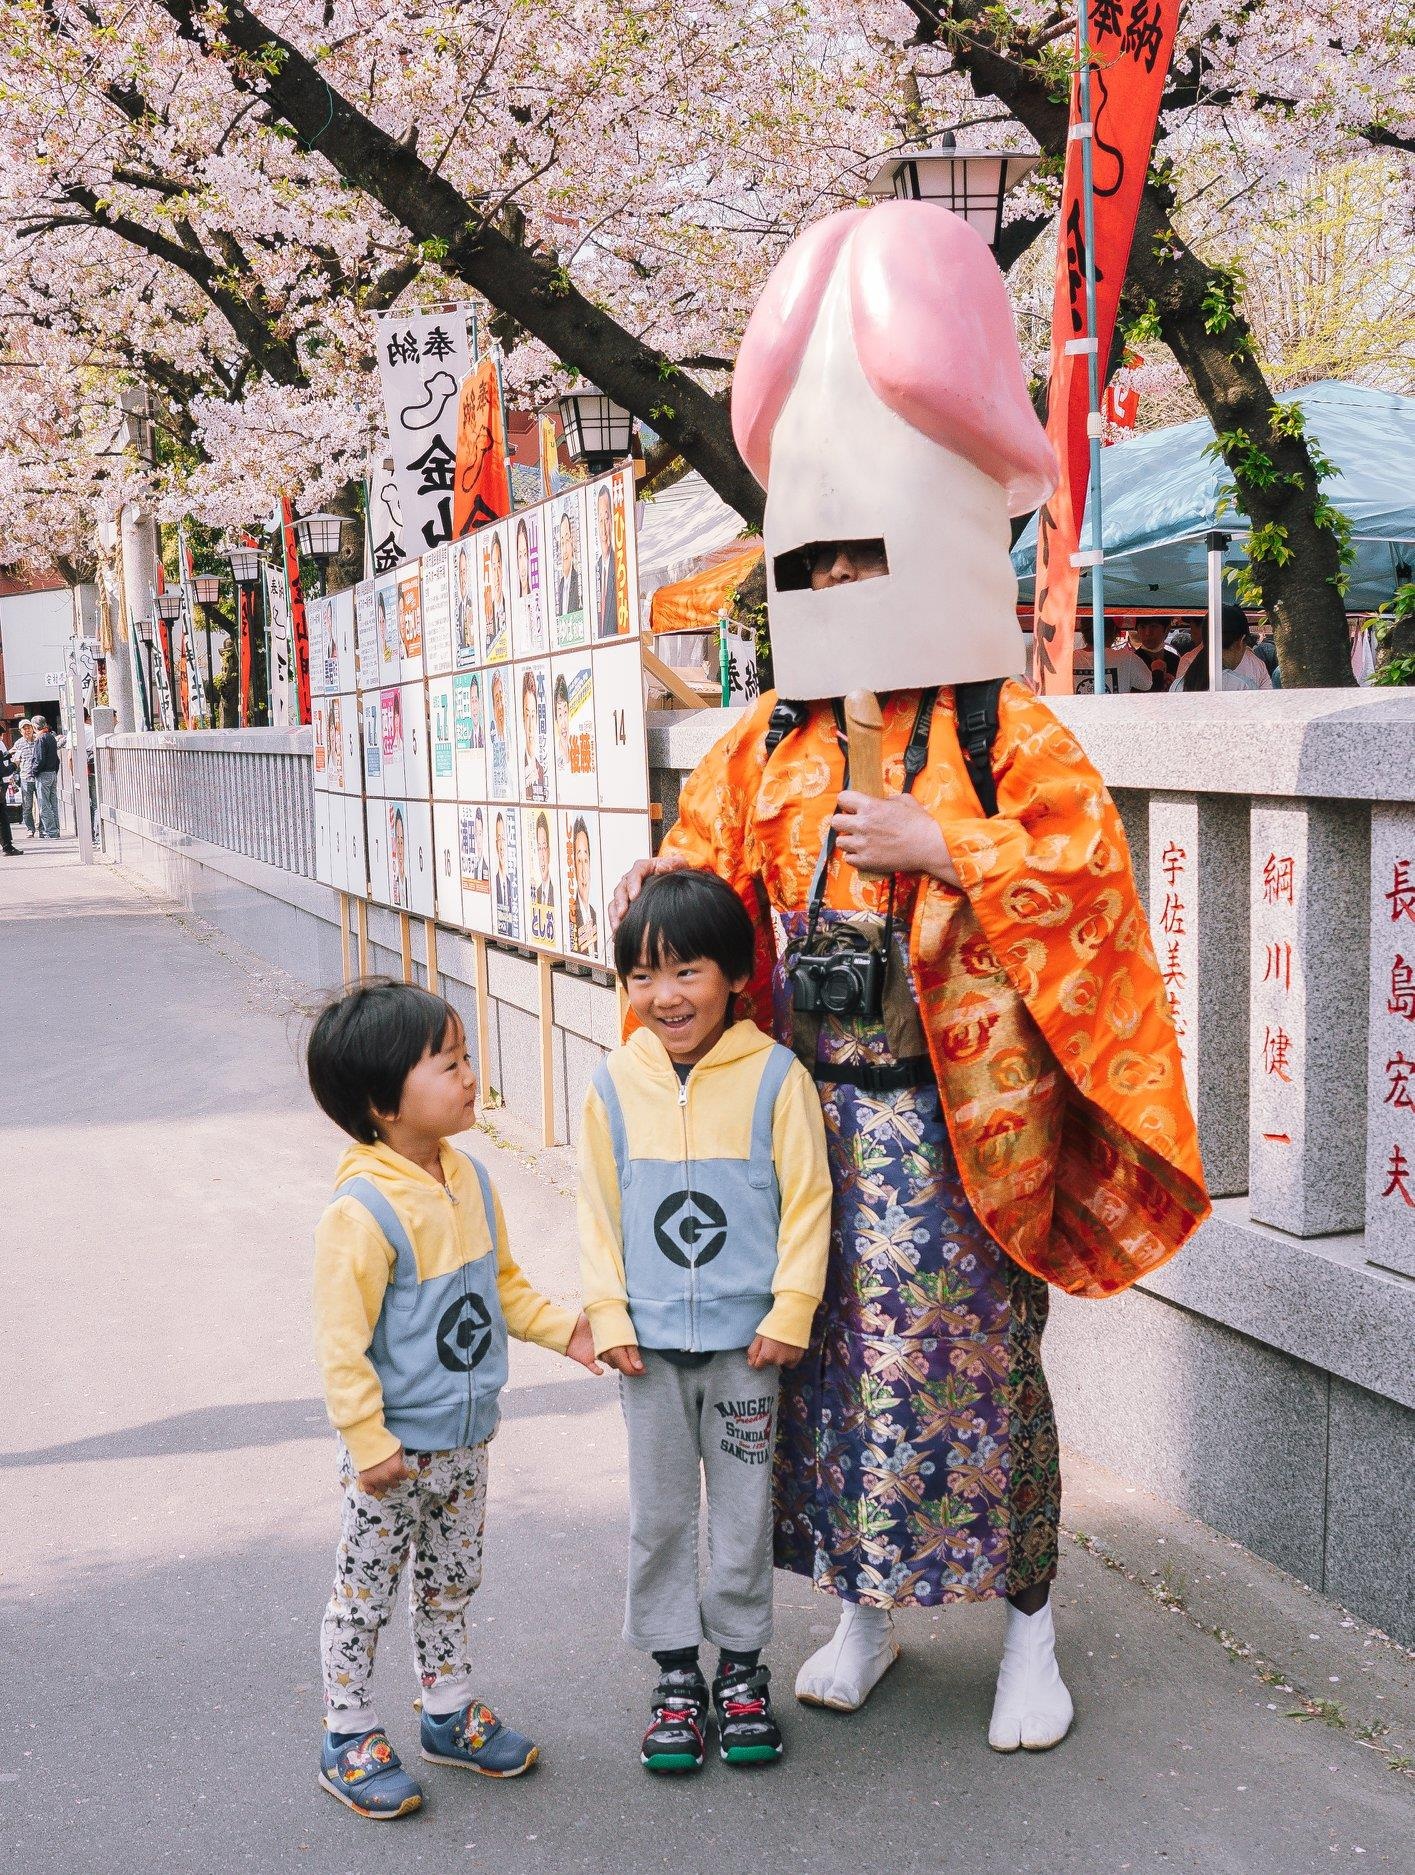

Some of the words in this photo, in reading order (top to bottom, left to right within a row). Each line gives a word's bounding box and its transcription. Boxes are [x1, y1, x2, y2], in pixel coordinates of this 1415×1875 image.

[613, 708, 627, 746] 14
[1381, 859, 1415, 1208] 長島宏夫
